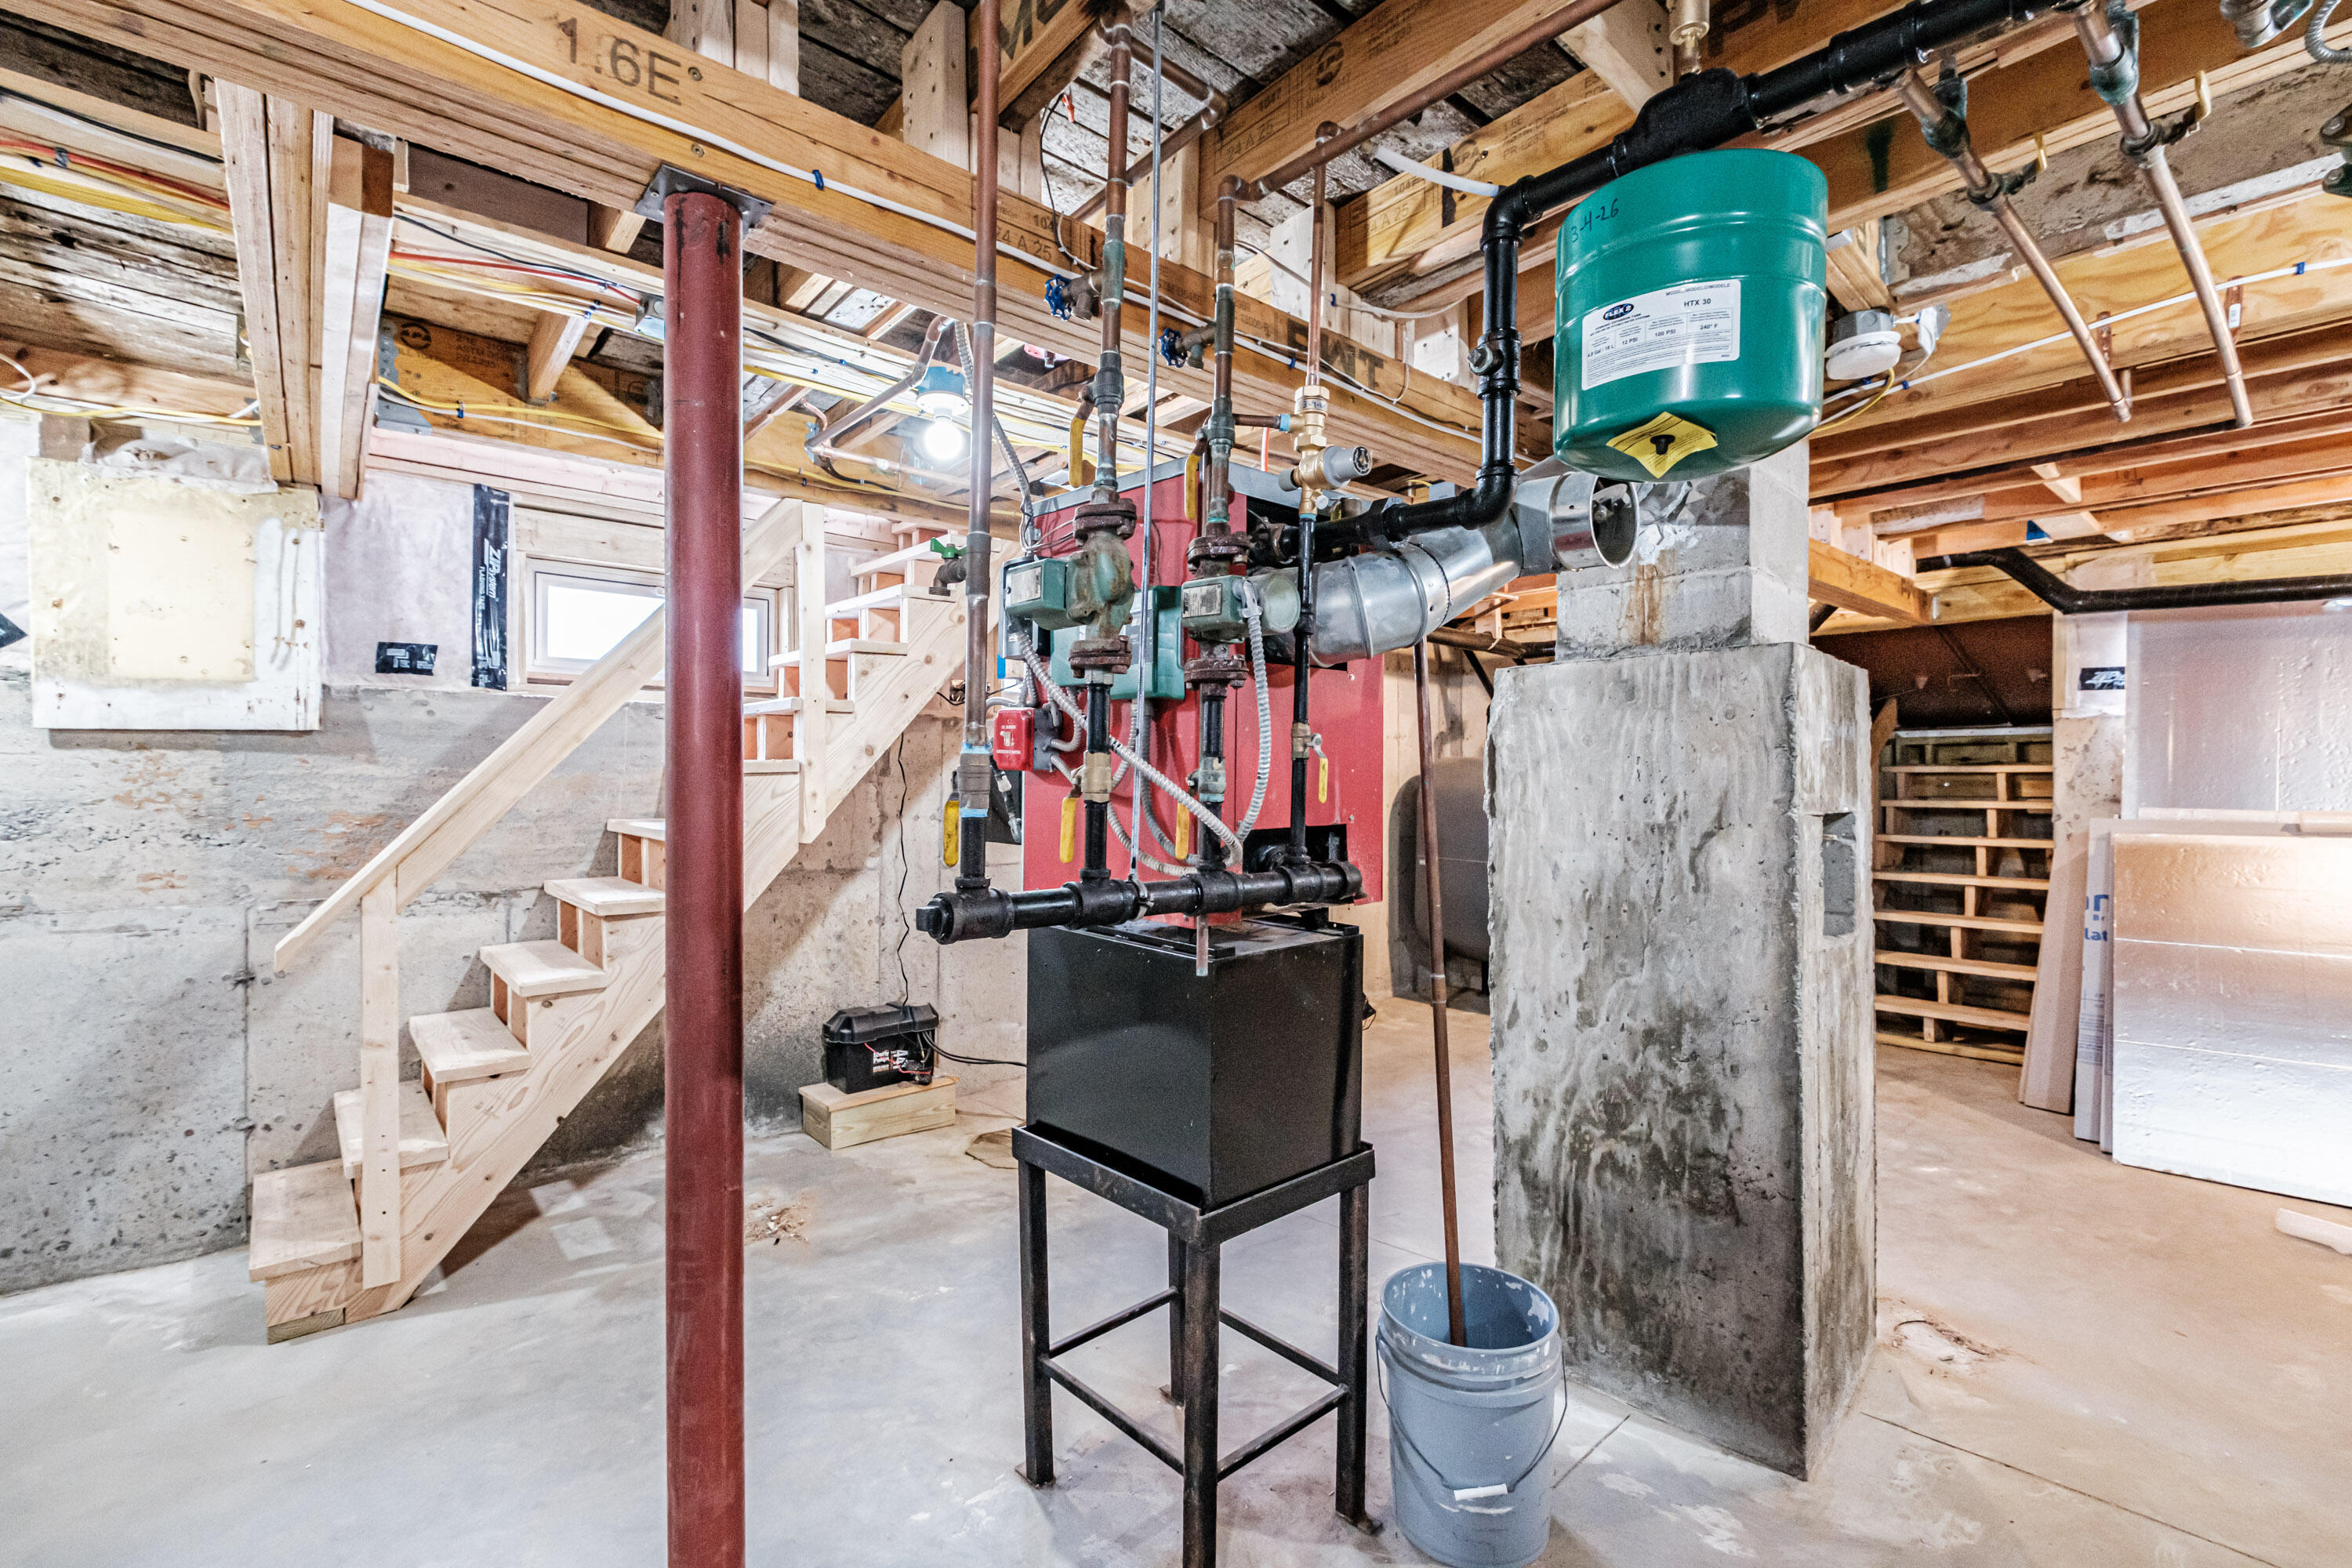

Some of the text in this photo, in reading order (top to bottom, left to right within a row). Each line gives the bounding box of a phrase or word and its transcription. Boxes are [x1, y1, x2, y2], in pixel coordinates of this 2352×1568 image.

[559, 16, 682, 107] 1.6E
[1570, 198, 1620, 244] 3-4-26
[1018, 234, 1029, 253] A
[1033, 239, 1052, 262] 25
